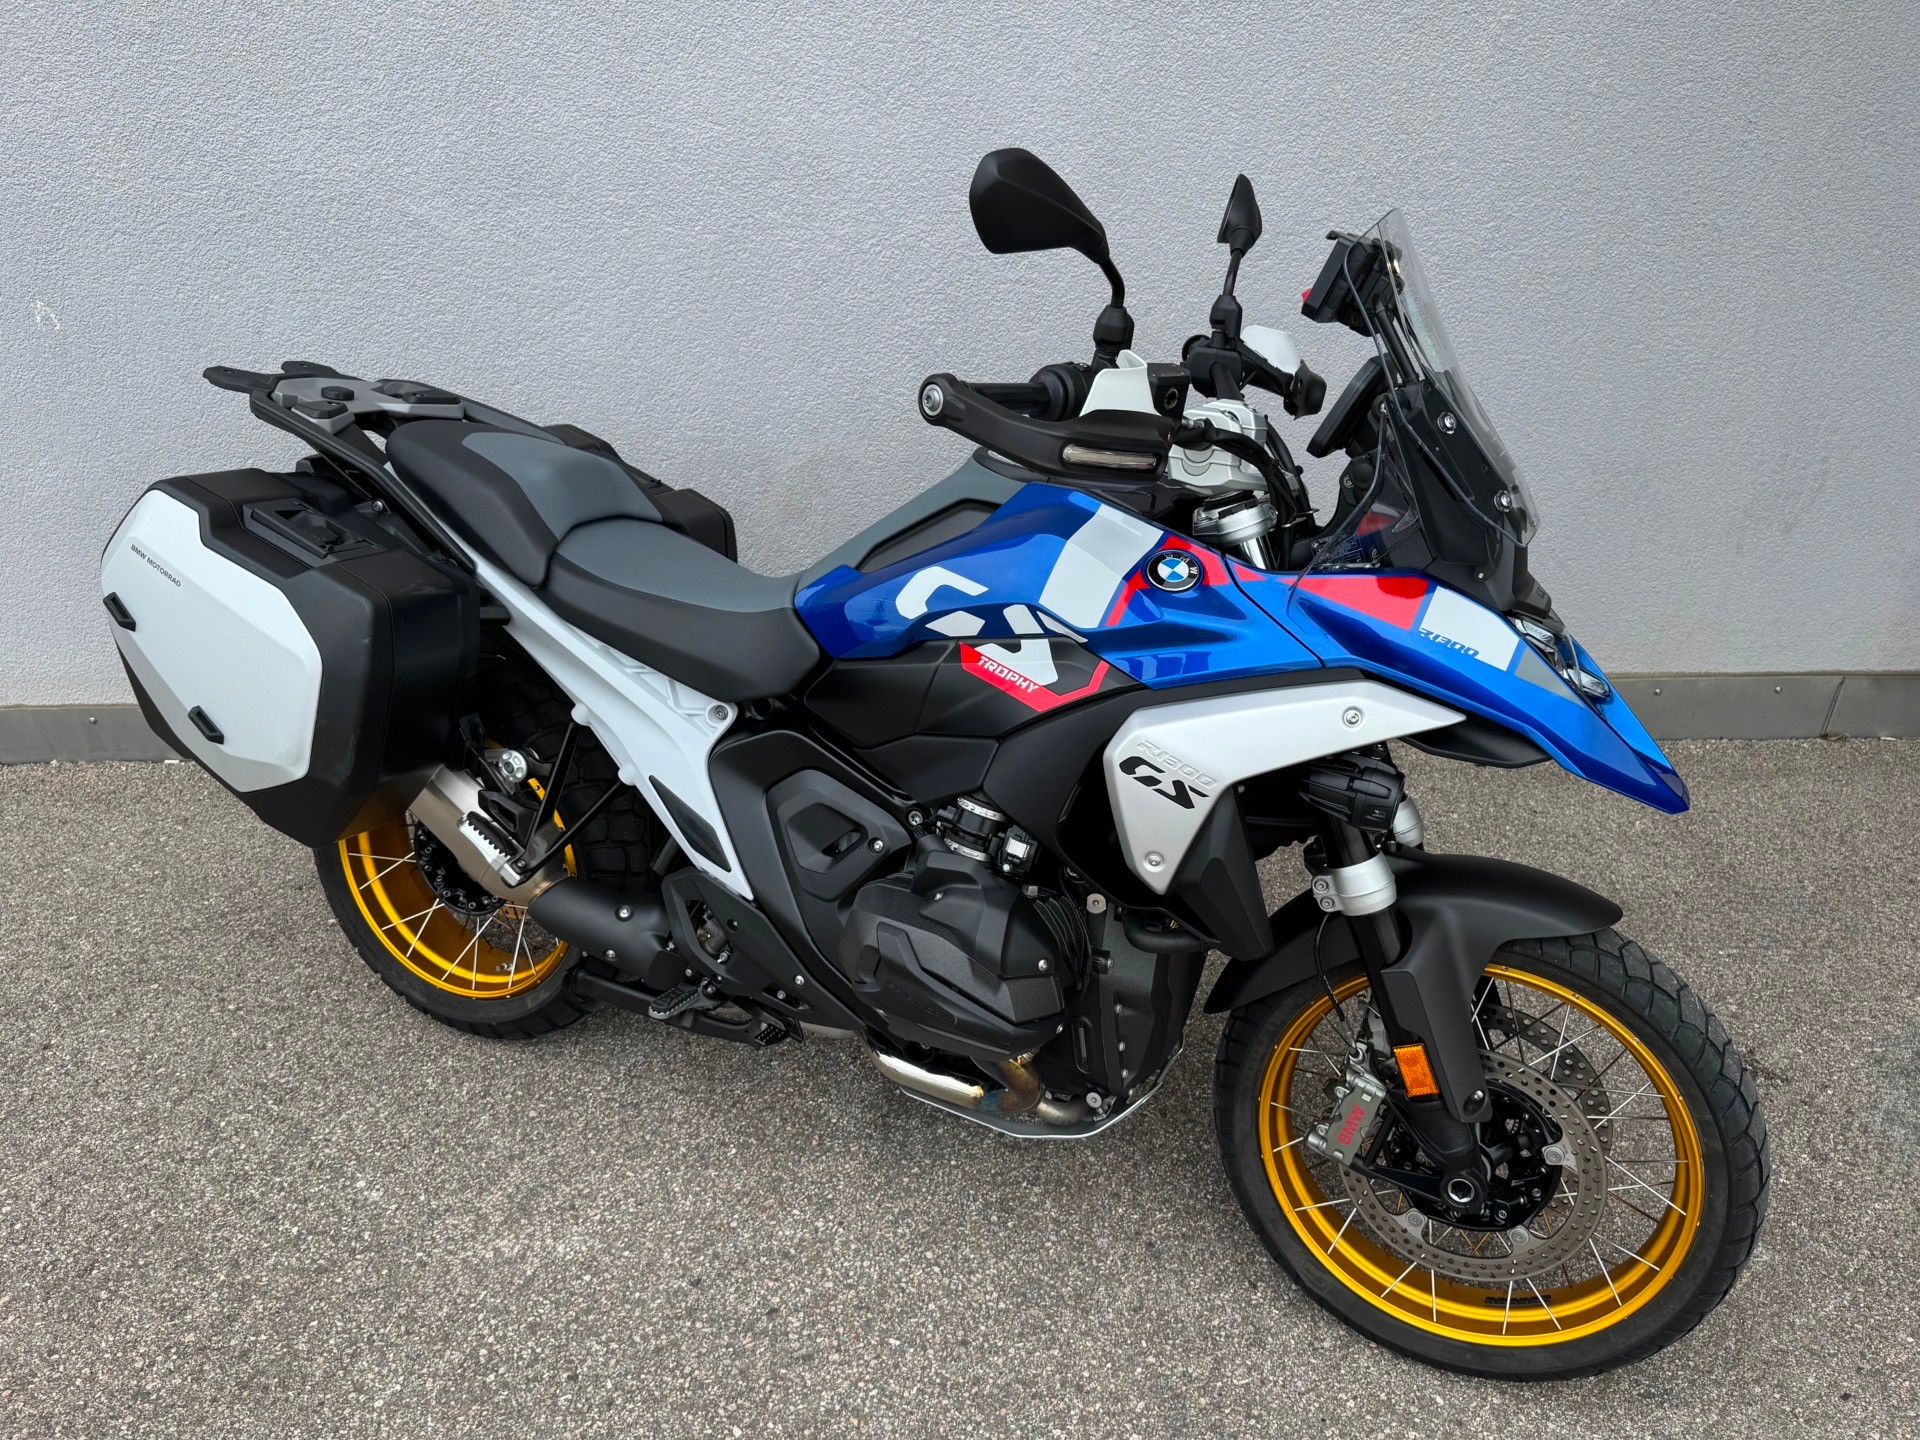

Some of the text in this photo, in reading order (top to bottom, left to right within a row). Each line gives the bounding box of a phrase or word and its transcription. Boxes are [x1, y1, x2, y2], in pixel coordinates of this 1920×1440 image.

[131, 544, 181, 587] BMW MOTORRAD
[1163, 552, 1199, 575] BMW
[977, 655, 1040, 693] TROPHY
[1119, 756, 1210, 809] GS
[1337, 1103, 1366, 1146] BMW
